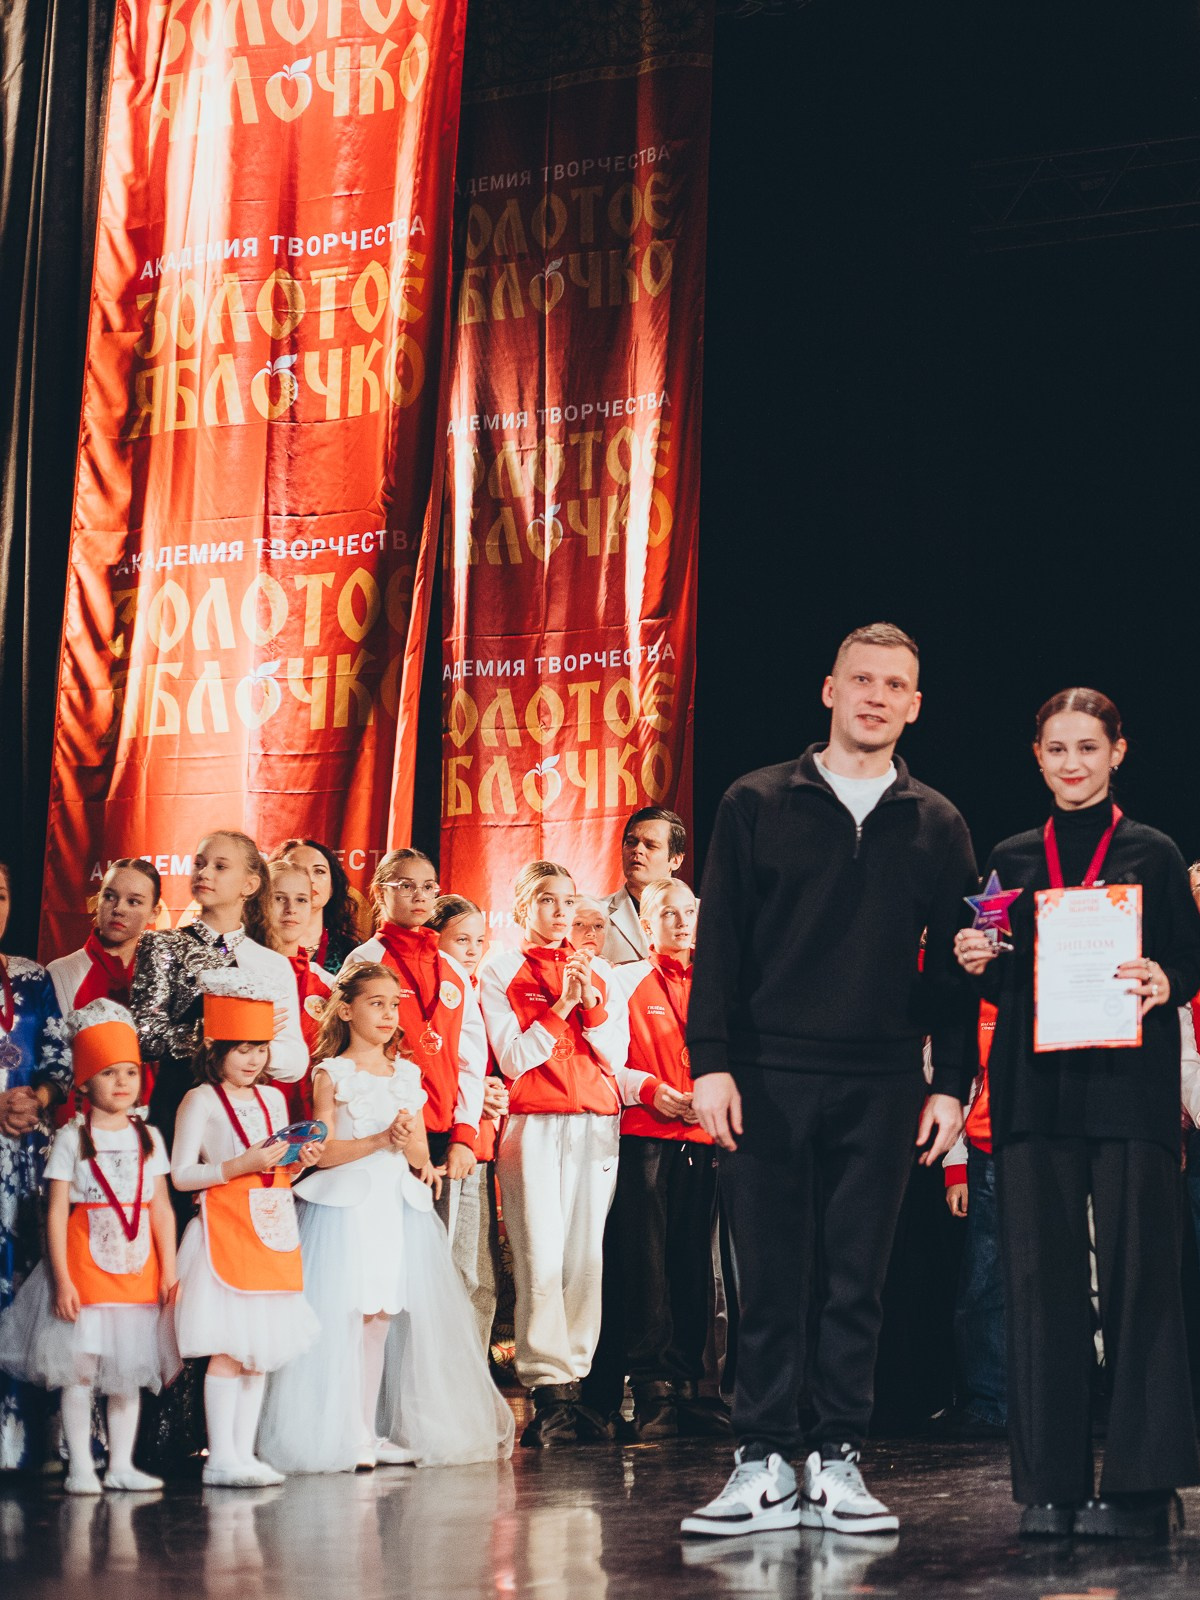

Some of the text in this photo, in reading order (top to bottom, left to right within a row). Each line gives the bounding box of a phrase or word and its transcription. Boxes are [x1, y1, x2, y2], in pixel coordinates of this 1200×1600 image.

[541, 144, 671, 182] ТВОРЧЕСТВА
[139, 214, 426, 281] АКАДЕМИЯ ТВОРЧЕСТВА
[133, 248, 427, 360] ЗОЛОТОЕ
[126, 333, 426, 441] ЯБЛОЧКО
[537, 390, 672, 425] ТВОРЧЕСТВА
[114, 539, 244, 577] АКАДЕМИЯ
[535, 643, 676, 675] ТВОРЧЕСТВА
[442, 671, 676, 750] ОЛОТОЕ
[441, 741, 673, 818] БЛОЧКО
